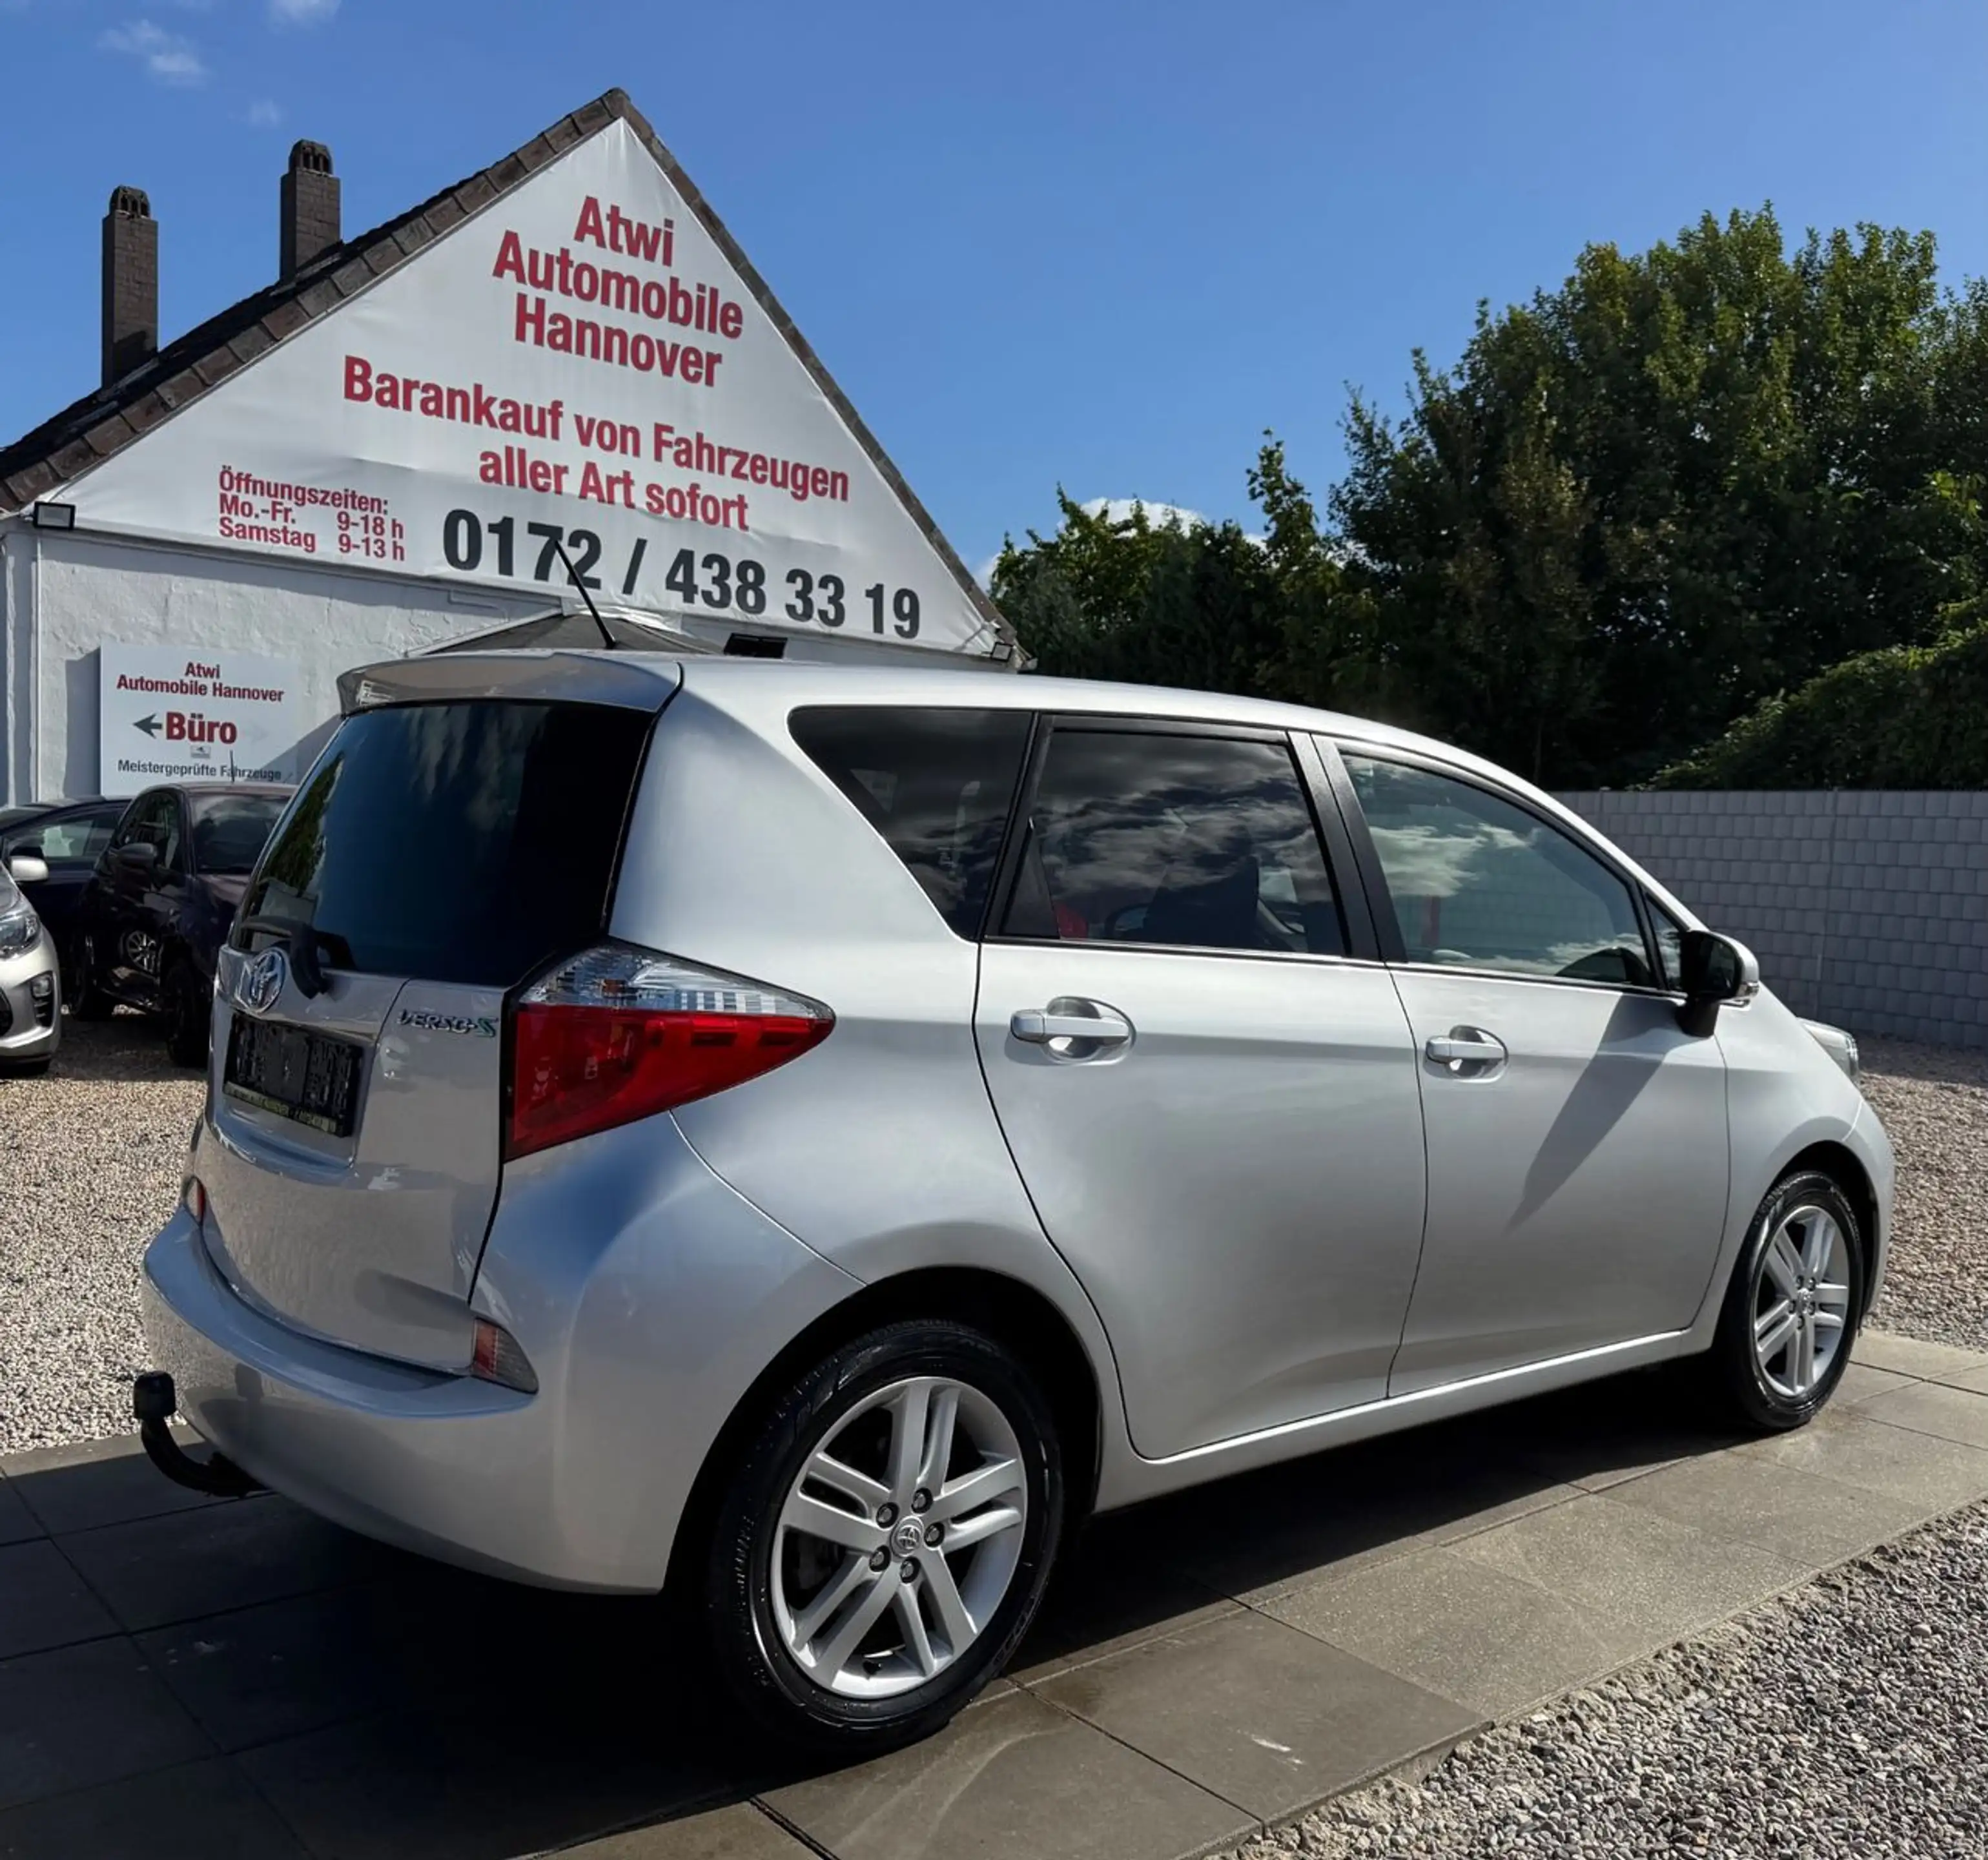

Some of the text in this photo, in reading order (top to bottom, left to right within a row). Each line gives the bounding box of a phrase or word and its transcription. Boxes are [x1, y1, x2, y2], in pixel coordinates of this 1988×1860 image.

[573, 196, 674, 267] Atwi
[492, 230, 743, 340] Automobile
[515, 293, 722, 388] Hannover
[344, 355, 848, 501] Barankauf von Fahrzeugen
[219, 464, 389, 515] Öffnungszeiten:
[479, 446, 750, 532] aller Art sofort
[219, 493, 404, 539] Mo.-Fr. 9-18 h
[219, 516, 405, 561] Samstag 9-13 h
[443, 508, 920, 639] 0172 / 438 33 19
[116, 674, 285, 702] Automobile Hannover
[185, 661, 221, 679] Atwi
[166, 712, 238, 744] Büro
[118, 760, 216, 777] Meistergeprüfte
[396, 1009, 498, 1037] VERSO-S
